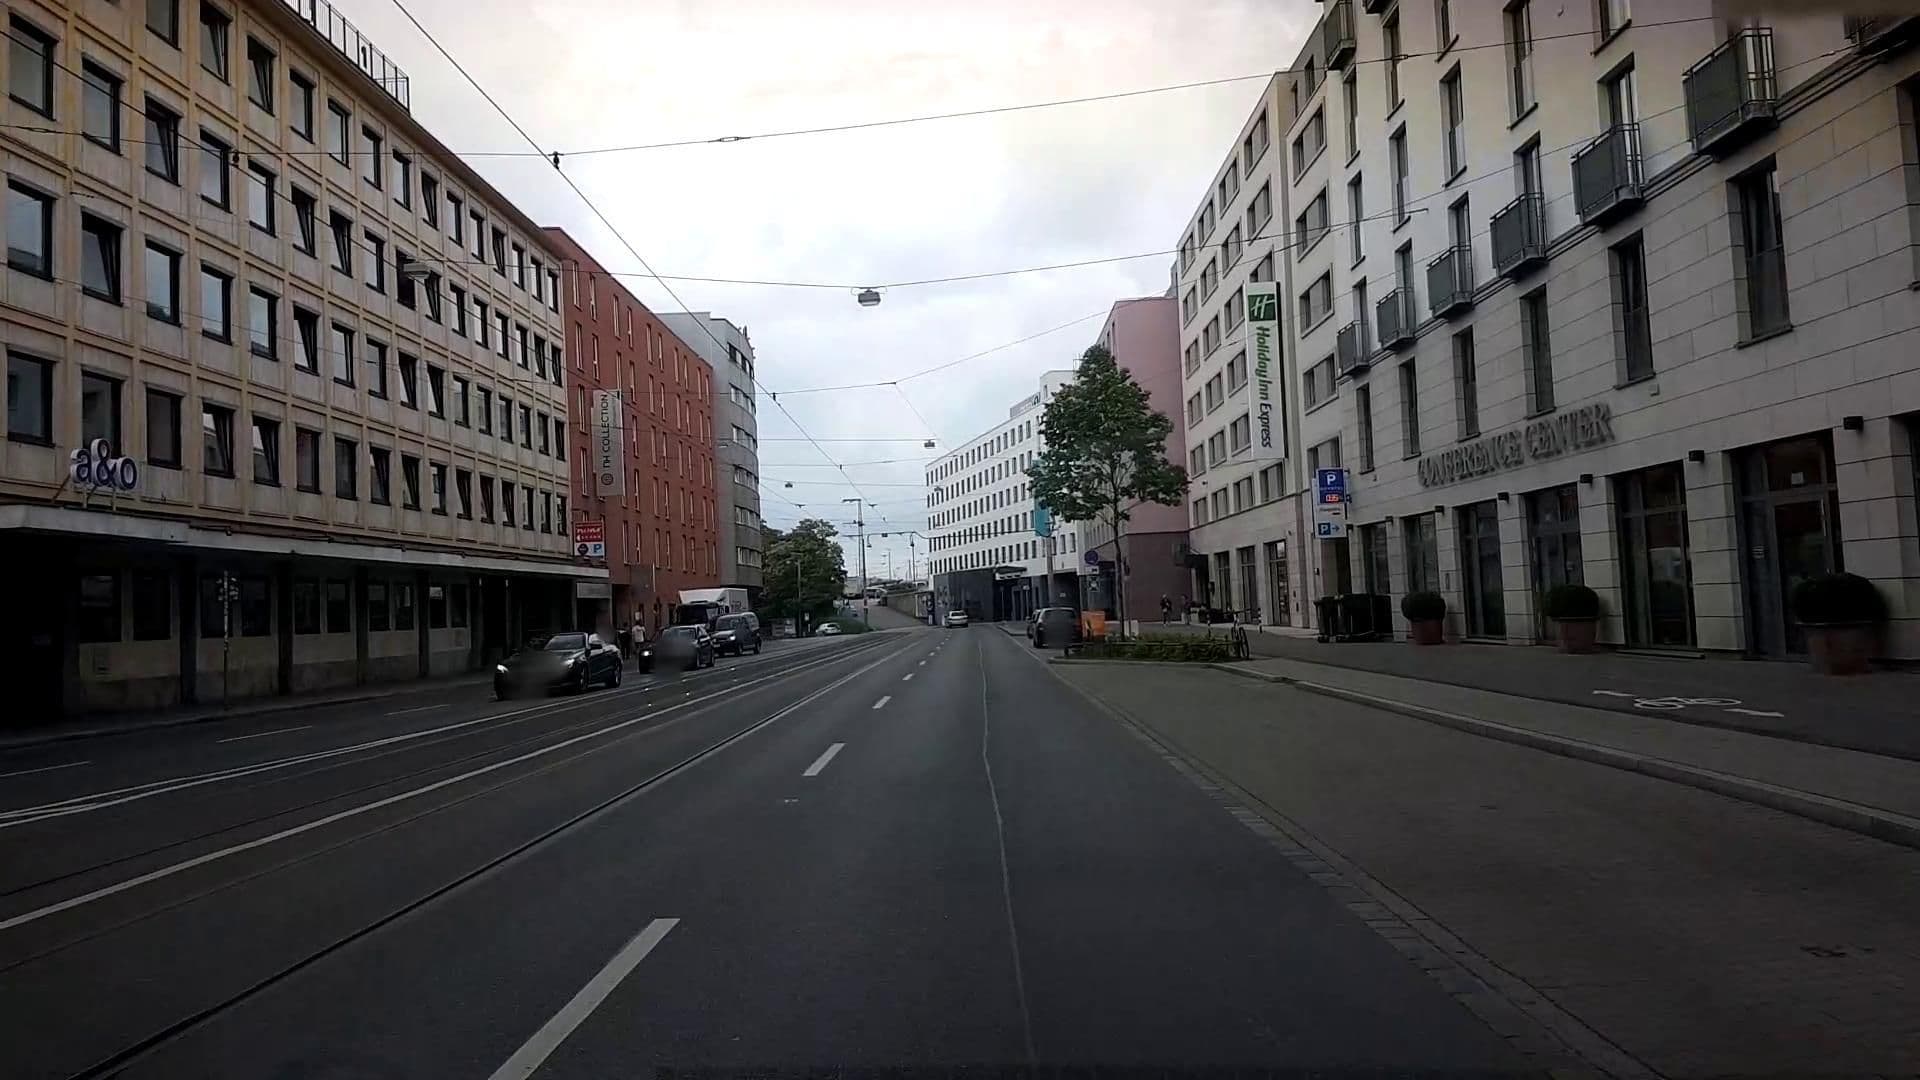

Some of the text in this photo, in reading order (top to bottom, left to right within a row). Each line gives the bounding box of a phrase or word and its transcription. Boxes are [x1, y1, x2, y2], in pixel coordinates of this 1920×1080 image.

[1255, 325, 1271, 378] Holiday
[600, 394, 610, 453] COLLECTION
[1258, 403, 1273, 449] Express
[1417, 403, 1616, 488] CONFERENCE CENTER
[70, 439, 138, 490] a&o
